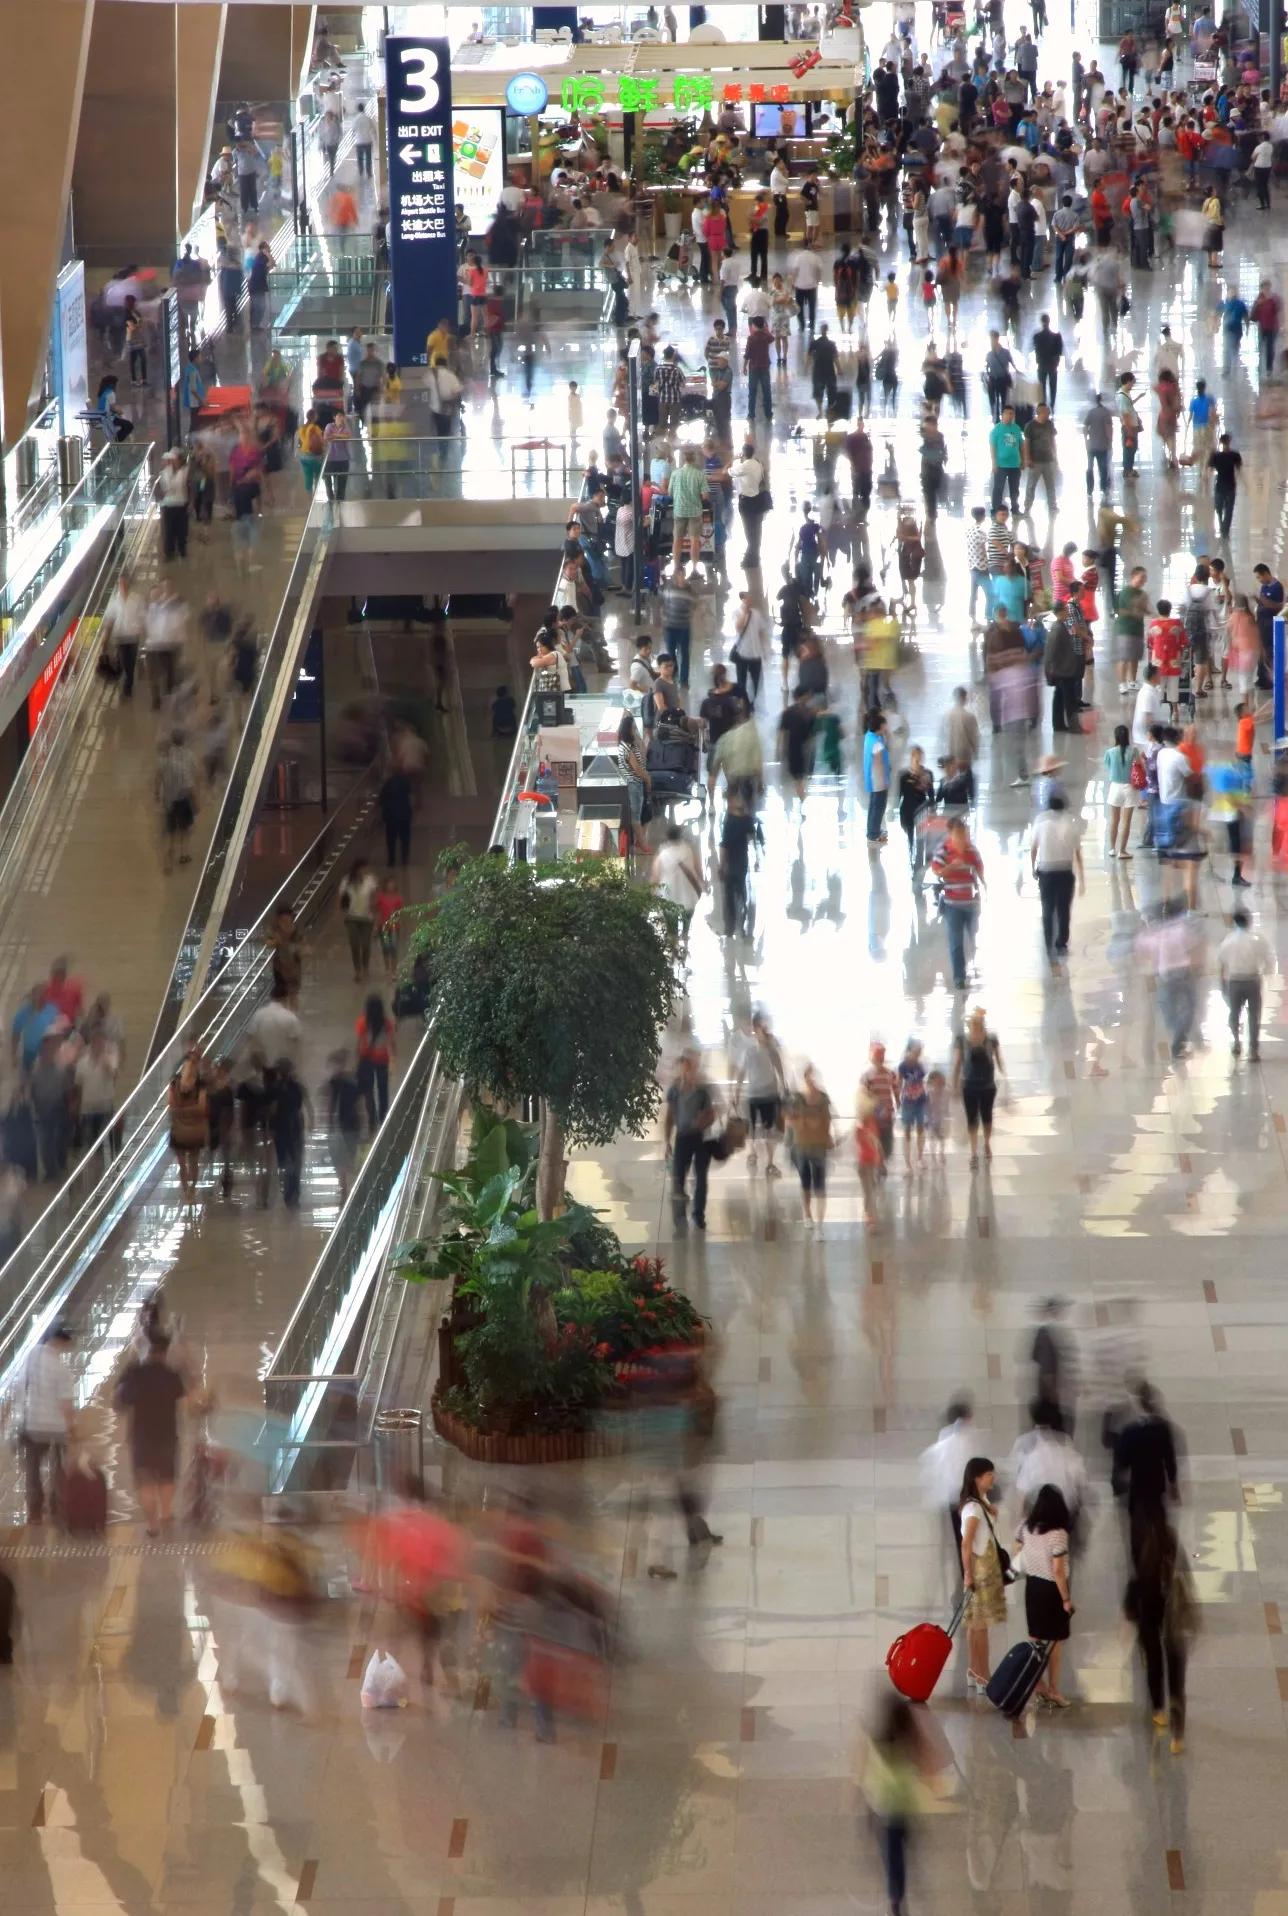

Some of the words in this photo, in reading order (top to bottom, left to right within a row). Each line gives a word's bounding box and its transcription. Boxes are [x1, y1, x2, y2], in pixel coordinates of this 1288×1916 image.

[400, 47, 440, 113] 3
[398, 125, 418, 137] 出口
[421, 125, 443, 137] EXIT
[412, 170, 444, 182] 出租车
[401, 194, 445, 206] 机场大巴
[401, 208, 418, 216] Airport
[401, 219, 445, 231] 长途大巴
